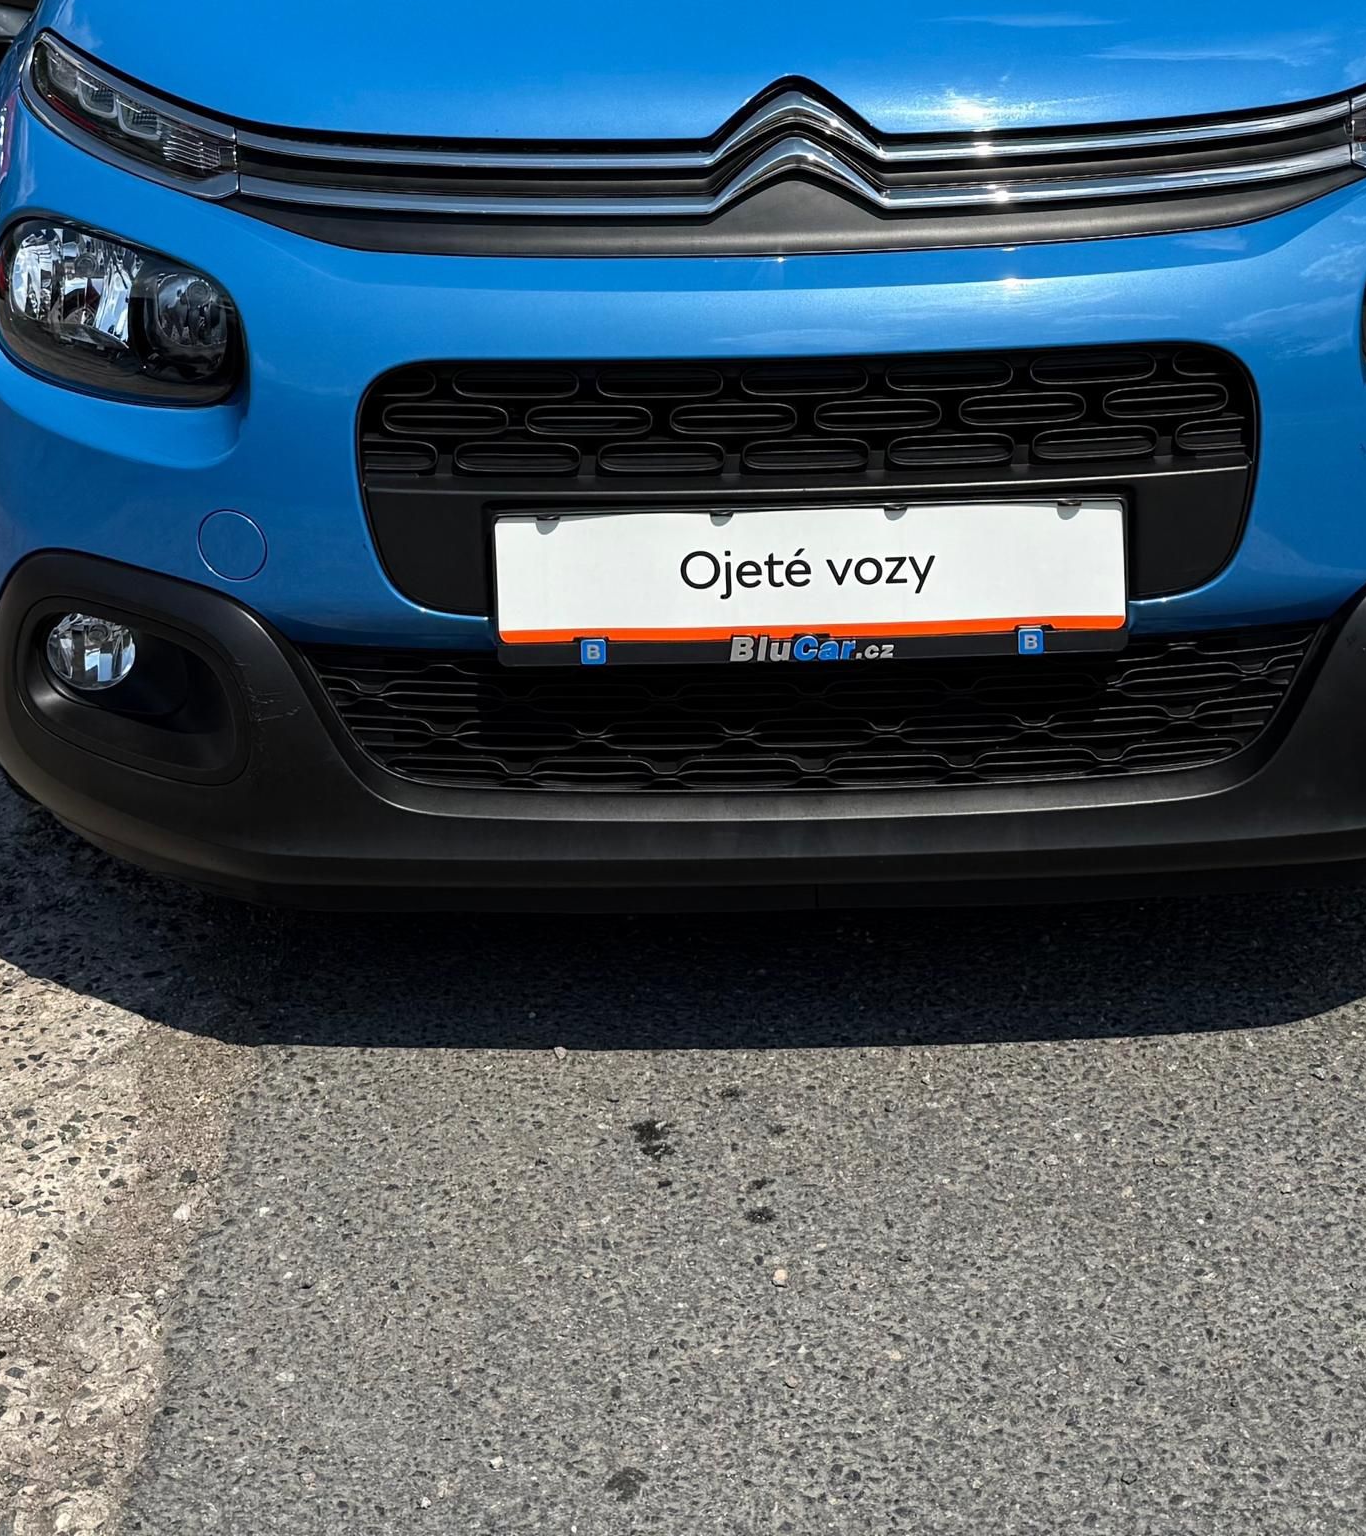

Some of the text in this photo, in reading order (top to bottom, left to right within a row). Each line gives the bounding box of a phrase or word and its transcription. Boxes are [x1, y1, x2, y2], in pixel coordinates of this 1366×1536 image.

[680, 549, 936, 600] Ojeté vozy
[730, 635, 895, 661] BluCar.cz
